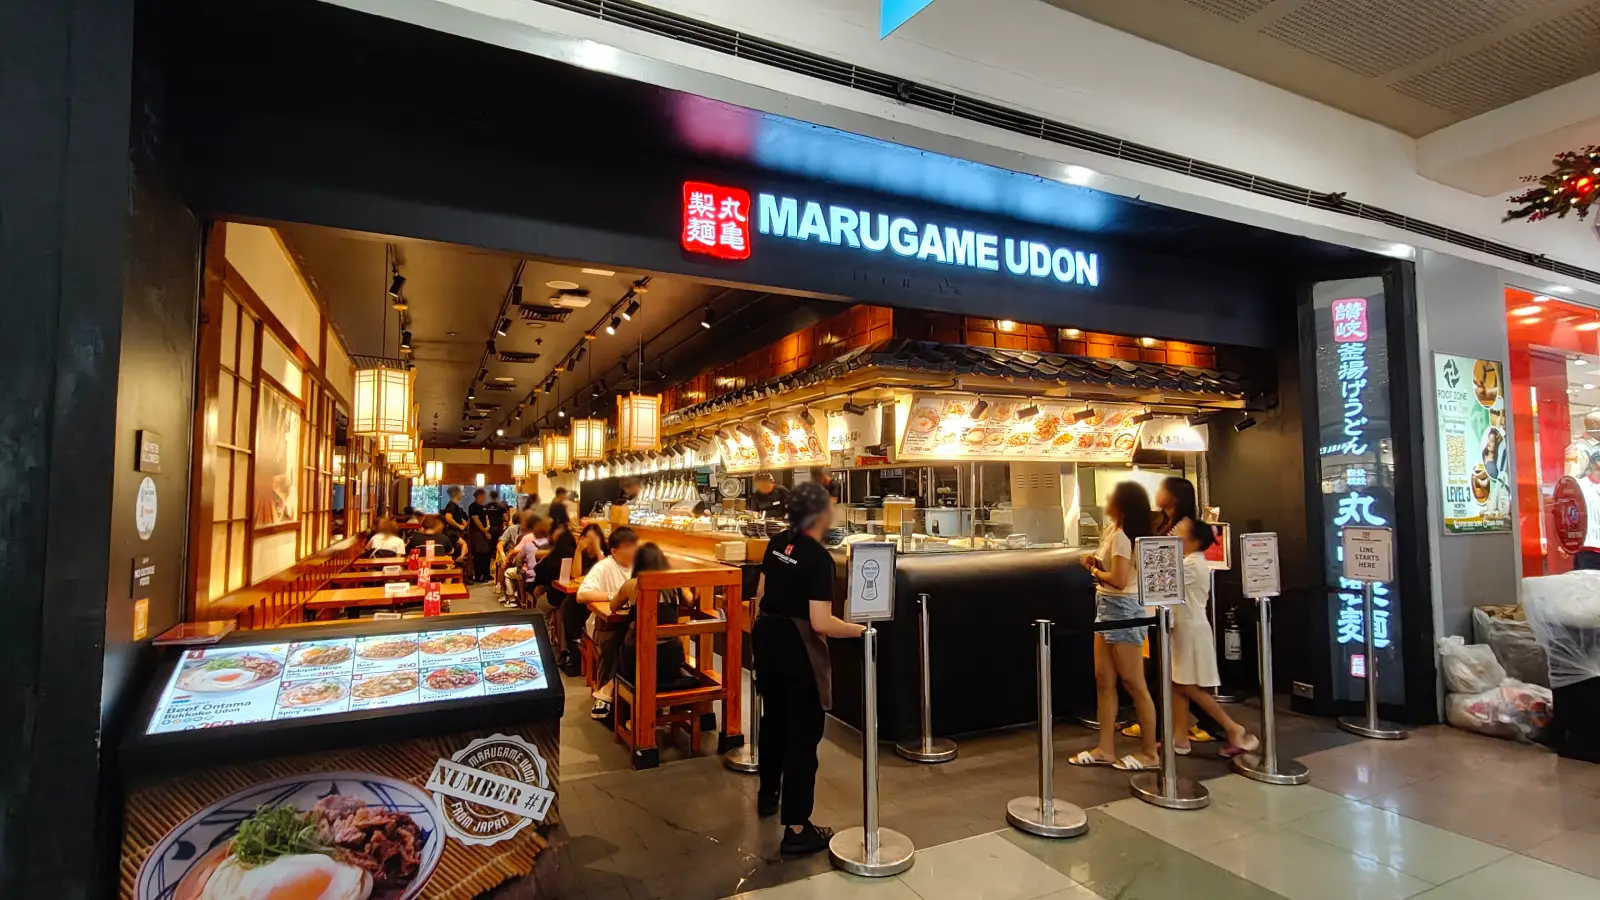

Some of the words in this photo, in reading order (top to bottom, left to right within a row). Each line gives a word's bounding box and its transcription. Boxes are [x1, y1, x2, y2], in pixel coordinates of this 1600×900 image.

[759, 193, 1000, 271] MARUGAME
[1004, 238, 1099, 287] UDON
[1337, 342, 1369, 455] 釜揚げうどん
[1446, 486, 1466, 503] LEVEL
[1466, 486, 1471, 503] 3
[1354, 553, 1380, 561] STARTS
[425, 591, 440, 601] 45
[164, 709, 212, 720] Bukkake
[214, 706, 240, 715] Udon
[166, 704, 202, 714] Beef
[202, 700, 252, 710] Ontama
[468, 746, 523, 767] MARUGAME
[519, 758, 536, 783] UDON
[431, 765, 522, 806] NUMBER
[524, 792, 549, 814] #1
[450, 801, 474, 829] FROM
[472, 815, 510, 833] JAPAN
